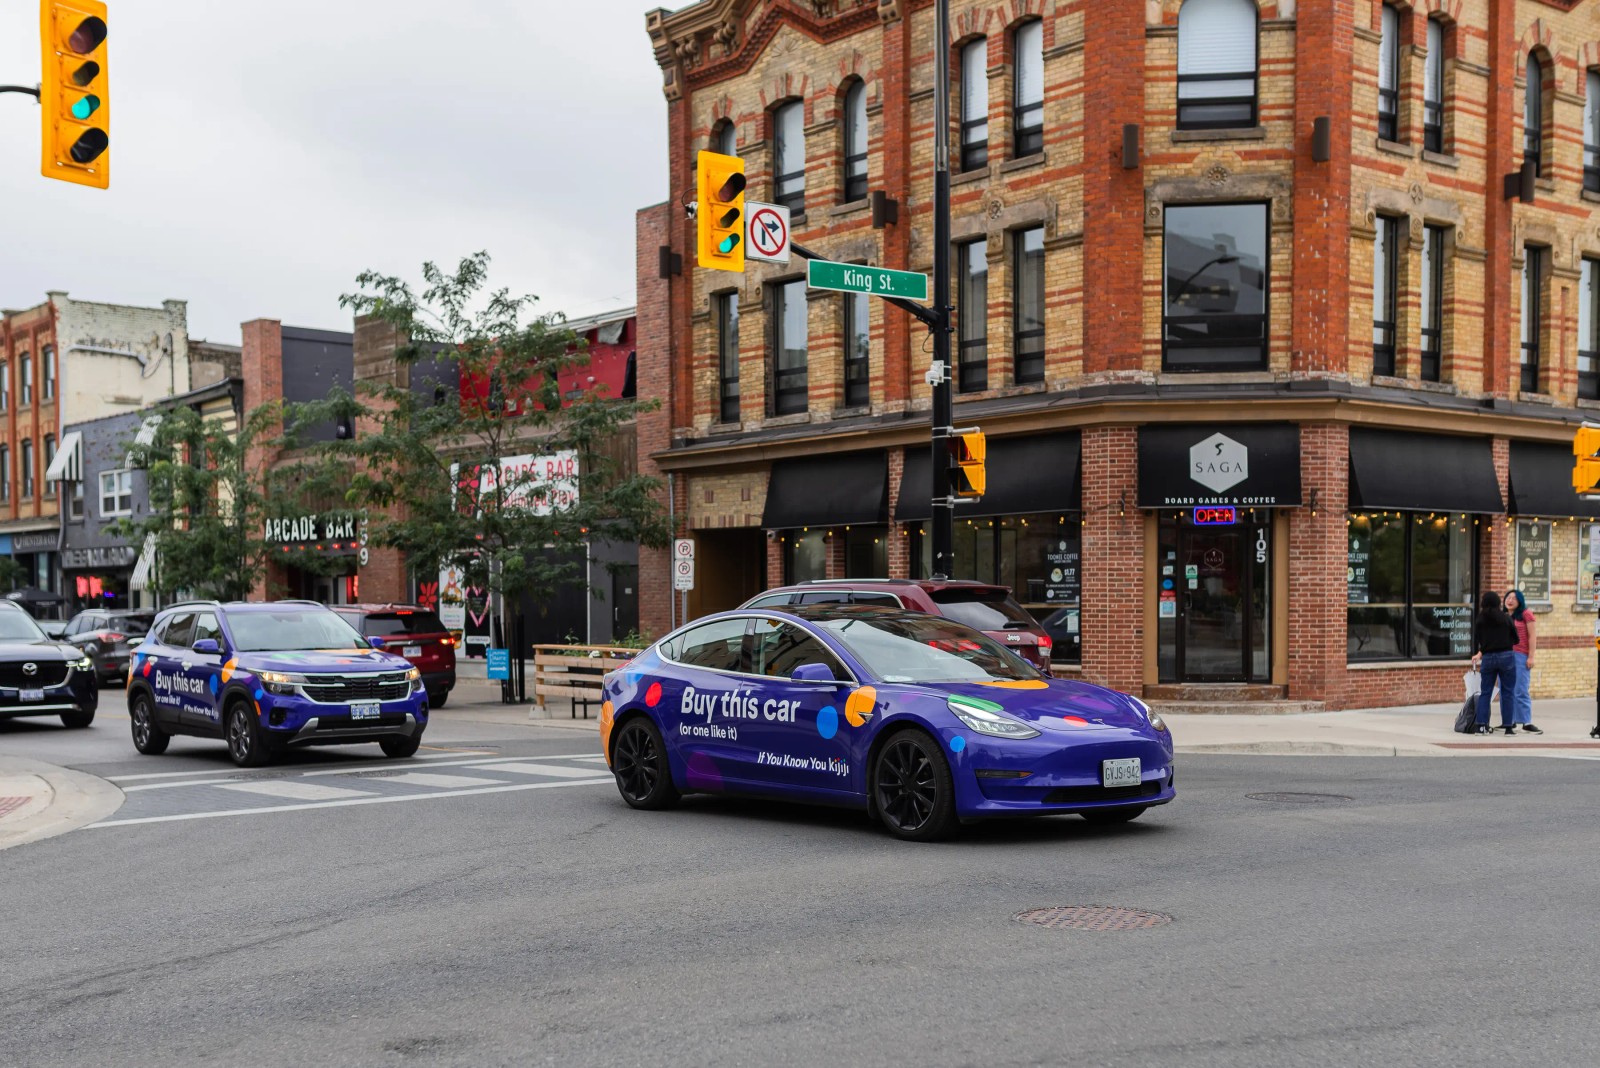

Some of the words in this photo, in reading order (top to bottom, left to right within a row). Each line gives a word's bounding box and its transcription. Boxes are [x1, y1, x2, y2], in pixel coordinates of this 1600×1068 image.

[843, 269, 873, 292] King
[879, 274, 895, 291] St.
[546, 458, 574, 481] BAR
[1195, 462, 1243, 473] SAGA
[1195, 508, 1234, 523] OPEN
[265, 514, 318, 542] ARCADE
[325, 515, 354, 539] BAR
[1256, 528, 1267, 563] 105
[1433, 607, 1455, 618] Specialty
[1440, 619, 1455, 629] Board
[1007, 634, 1021, 642] Jeep
[155, 669, 172, 695] Buy
[173, 671, 189, 692] this
[189, 678, 204, 694] car
[161, 696, 169, 704] one
[168, 695, 176, 705] like
[681, 686, 717, 724] Buy
[721, 688, 759, 720] this
[763, 698, 802, 723] car
[194, 706, 205, 714] Know
[679, 722, 692, 736] (or
[693, 726, 709, 737] one
[711, 726, 726, 739] like
[728, 726, 738, 741] it)
[757, 751, 765, 764] If
[766, 753, 782, 766] You
[783, 754, 809, 769] Know
[809, 757, 827, 771] You
